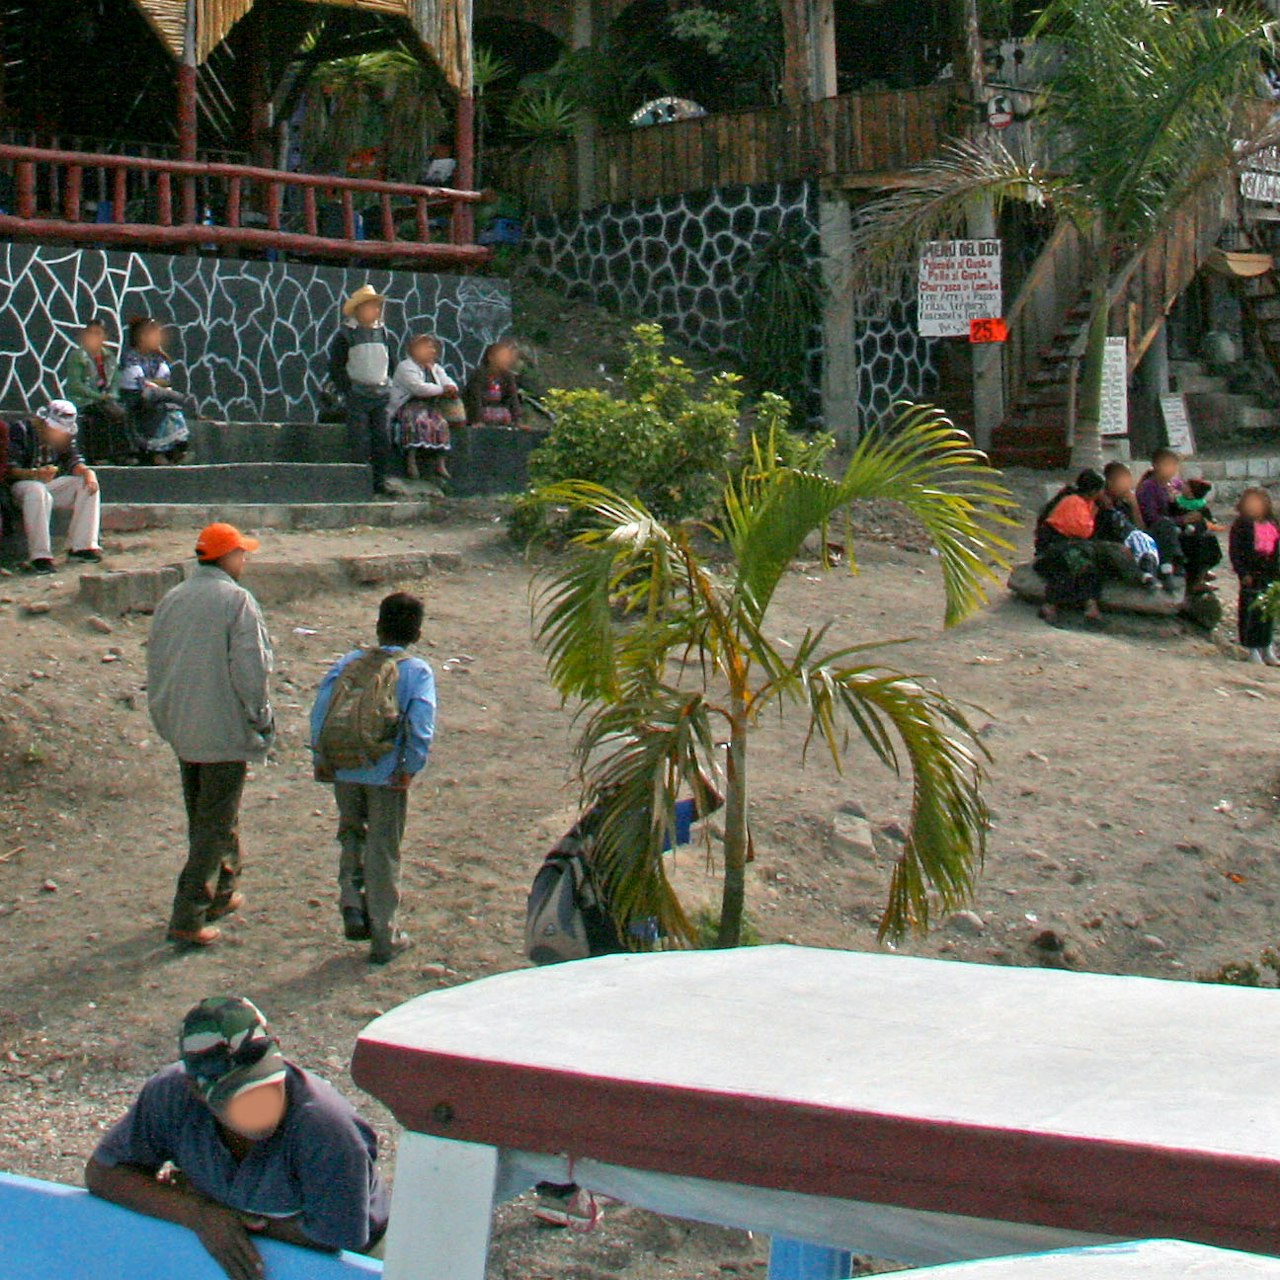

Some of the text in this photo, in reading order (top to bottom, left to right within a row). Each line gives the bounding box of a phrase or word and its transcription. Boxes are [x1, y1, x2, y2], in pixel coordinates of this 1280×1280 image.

[959, 242, 977, 256] DEL
[979, 242, 999, 256] DIA
[966, 258, 993, 269] Gusto
[928, 270, 950, 281] Pollo
[961, 269, 988, 280] Gusto
